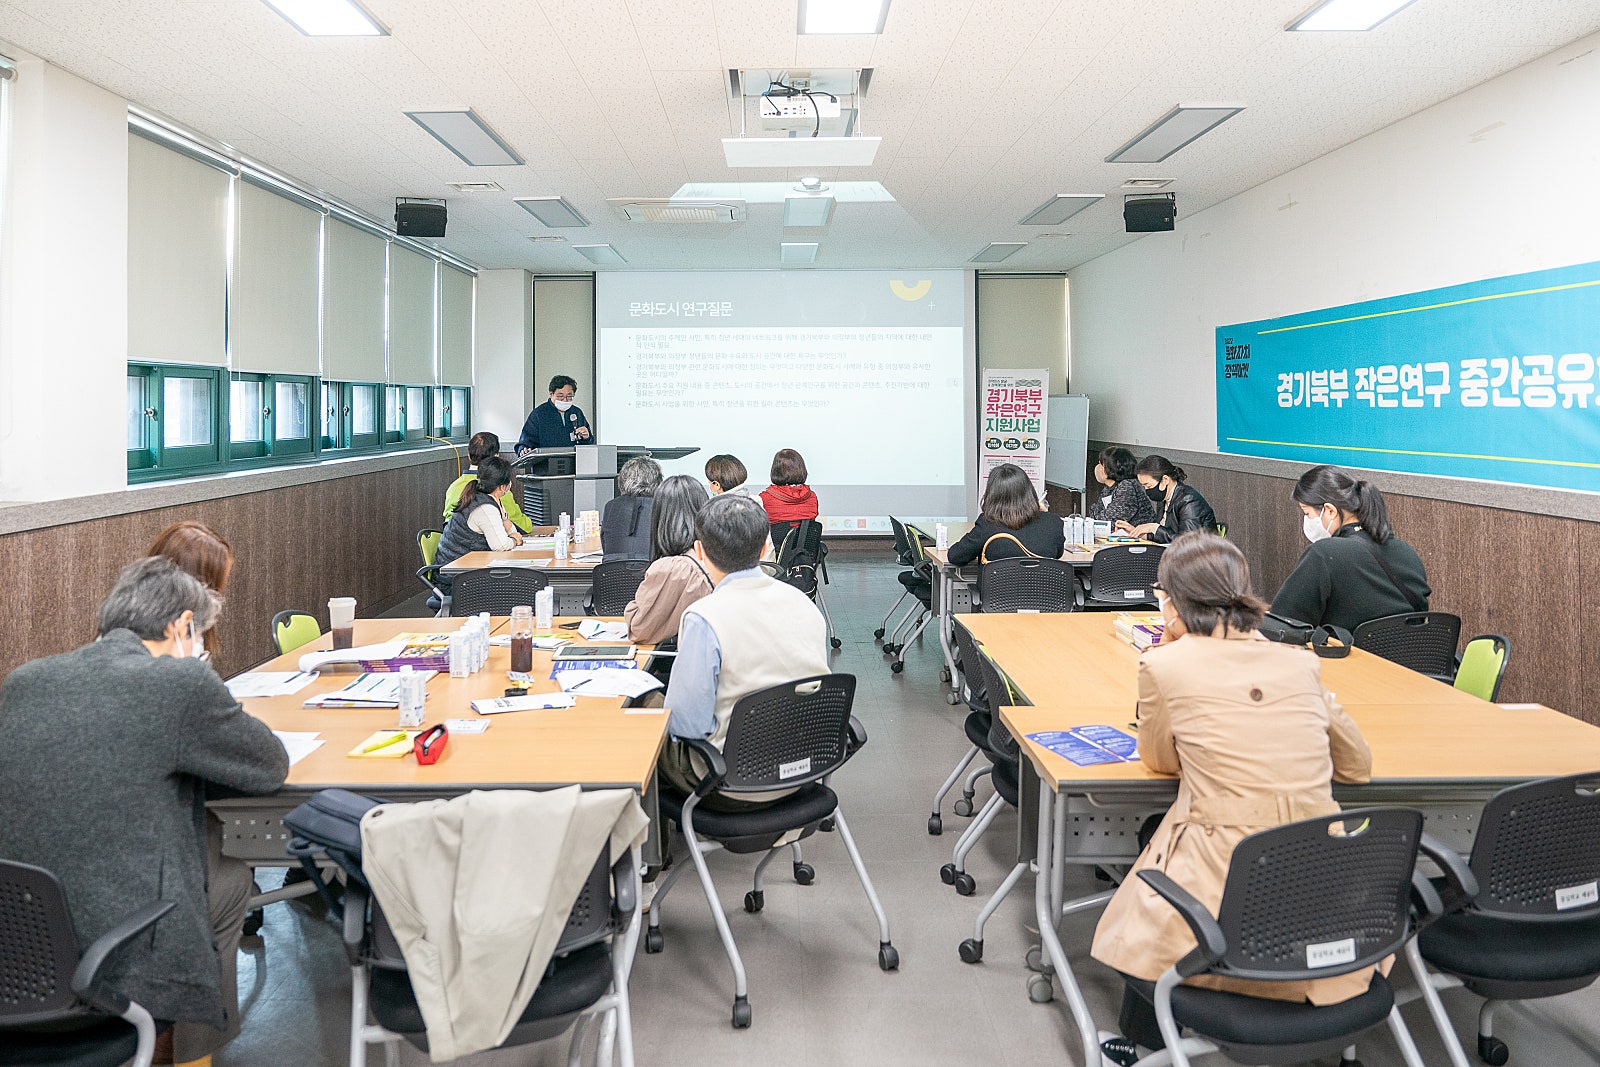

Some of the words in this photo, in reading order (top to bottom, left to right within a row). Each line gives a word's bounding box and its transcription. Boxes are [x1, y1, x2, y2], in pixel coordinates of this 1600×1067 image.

[629, 301, 680, 317] 문화도시
[682, 301, 734, 317] 연구질문
[1276, 367, 1349, 408] 경기북부
[1354, 361, 1451, 408] 작은연구
[1459, 352, 1600, 409] 중간공유
[987, 388, 1043, 403] 경기북부
[986, 403, 1042, 418] 작은연구
[985, 418, 1041, 433] 지원사업
